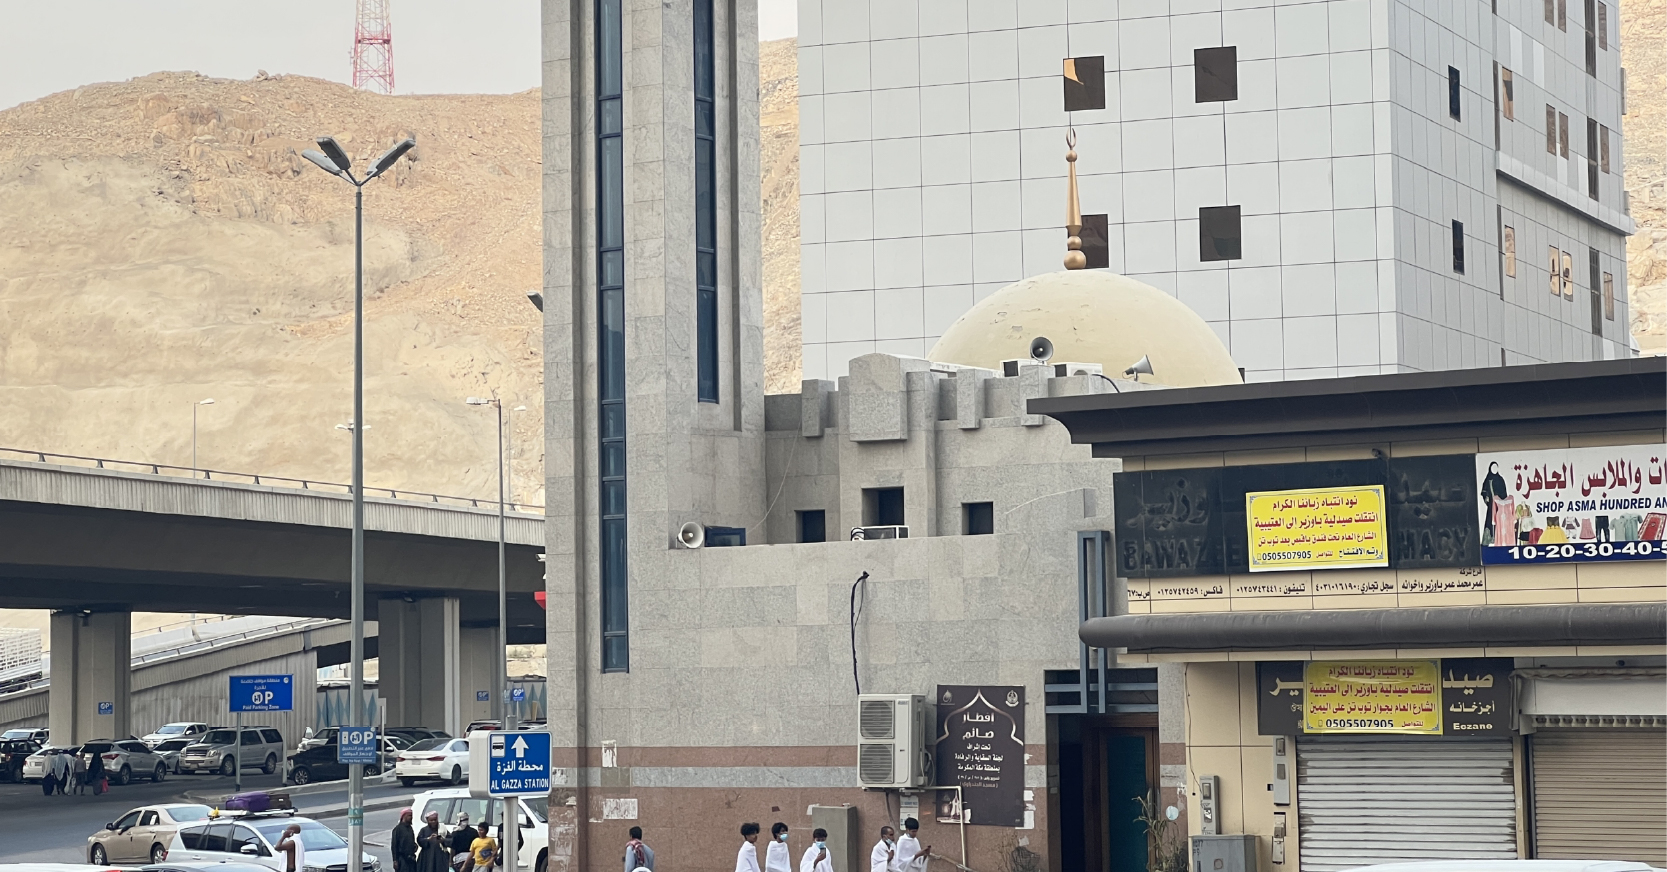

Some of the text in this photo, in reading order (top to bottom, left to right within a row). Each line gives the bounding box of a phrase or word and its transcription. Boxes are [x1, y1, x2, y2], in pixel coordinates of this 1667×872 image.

[1513, 462, 1574, 499] الجاهزة
[1582, 458, 1641, 498] والملابس
[1273, 498, 1296, 511] الكرام
[1345, 495, 1358, 508] نود
[1536, 501, 1564, 513] SHOP
[1567, 499, 1596, 512] ASMA
[1600, 497, 1651, 511] HUNDRED
[1299, 515, 1323, 529] باوزير
[1323, 513, 1353, 527] صيدلية
[1354, 511, 1379, 522] انتقلت
[1312, 534, 1327, 544] فندق
[1327, 532, 1340, 541] تحت
[1341, 533, 1356, 542] العام
[1357, 531, 1377, 543] الشارع
[1262, 550, 1312, 561] 0505507905
[1380, 581, 1394, 592] سجل
[1329, 665, 1352, 678] الكرام
[1410, 683, 1435, 694] انتقلت
[1443, 669, 1494, 695] صيد
[1309, 682, 1339, 697] العتيبية
[1354, 683, 1378, 697] باوزير
[1379, 683, 1409, 697] صيدلية
[265, 691, 273, 704] P
[1309, 702, 1331, 714] اليمين
[1332, 703, 1345, 714] على
[1372, 704, 1393, 714] بجوار
[1395, 702, 1412, 713] العام
[1413, 701, 1436, 715] الشارع
[1325, 719, 1394, 728] 0505507905
[364, 731, 374, 745] P
[962, 727, 995, 740] صائم
[496, 759, 544, 775] محطة الغزة
[490, 778, 549, 790] AL GAZZA STATION
